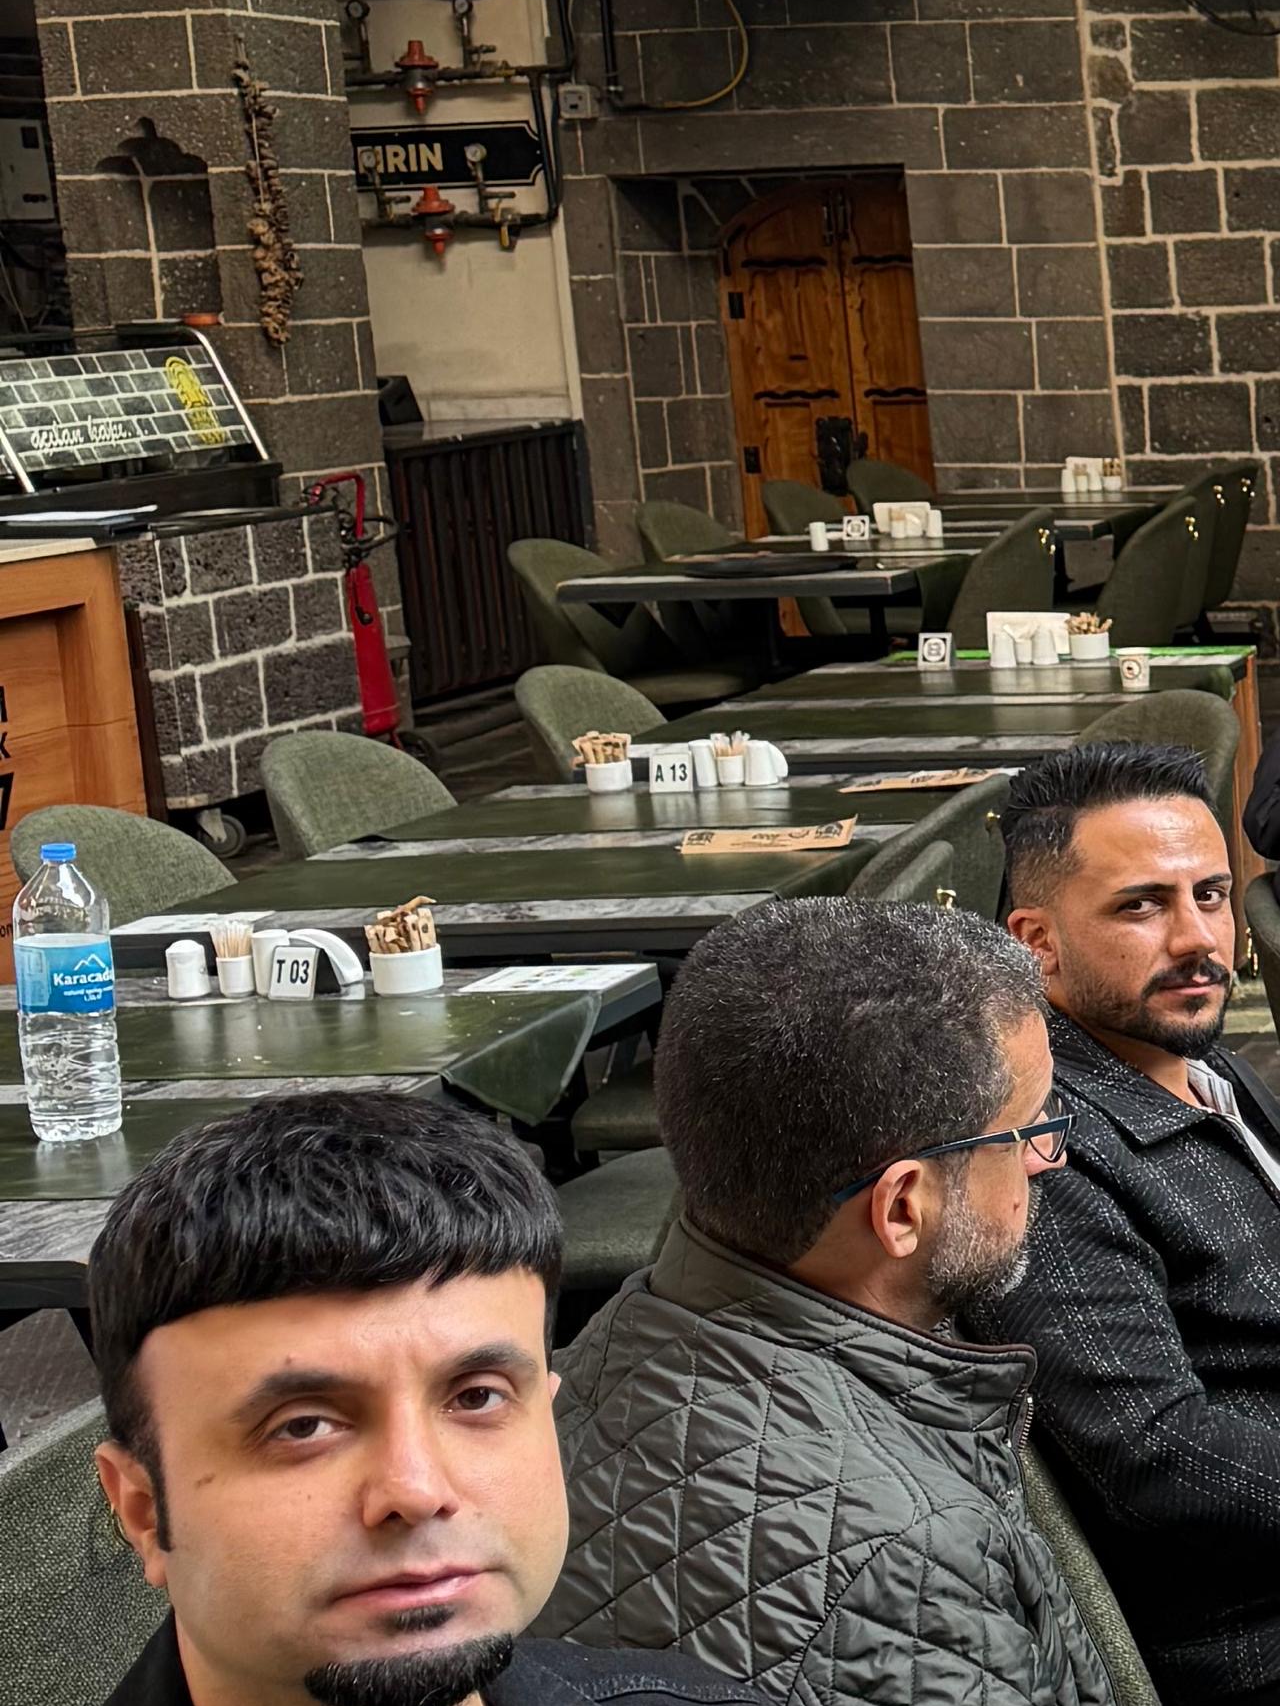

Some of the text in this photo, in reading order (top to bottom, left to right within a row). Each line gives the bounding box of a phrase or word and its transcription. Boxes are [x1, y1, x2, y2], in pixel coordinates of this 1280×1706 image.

[654, 763, 689, 782] A 13
[275, 956, 310, 985] T 03
